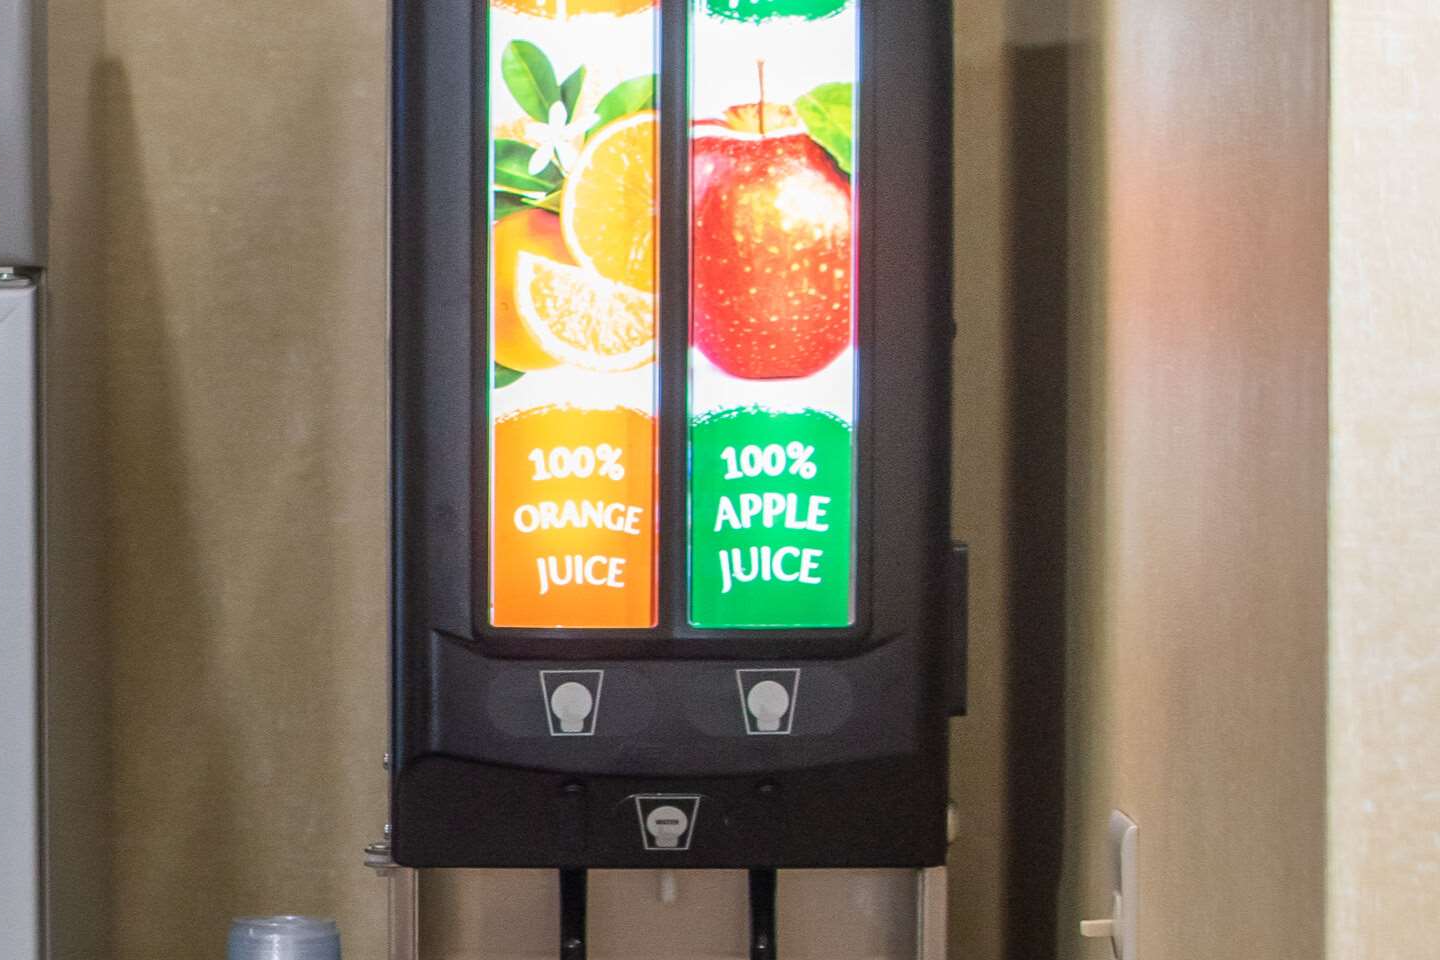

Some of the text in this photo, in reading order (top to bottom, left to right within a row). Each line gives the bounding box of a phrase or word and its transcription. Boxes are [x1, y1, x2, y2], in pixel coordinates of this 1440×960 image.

[528, 443, 625, 481] 100%
[720, 441, 817, 480] 100%
[513, 499, 644, 535] ORANGE
[714, 492, 831, 532] APPLE
[536, 555, 626, 595] JUICE
[719, 546, 823, 594] JUICE
